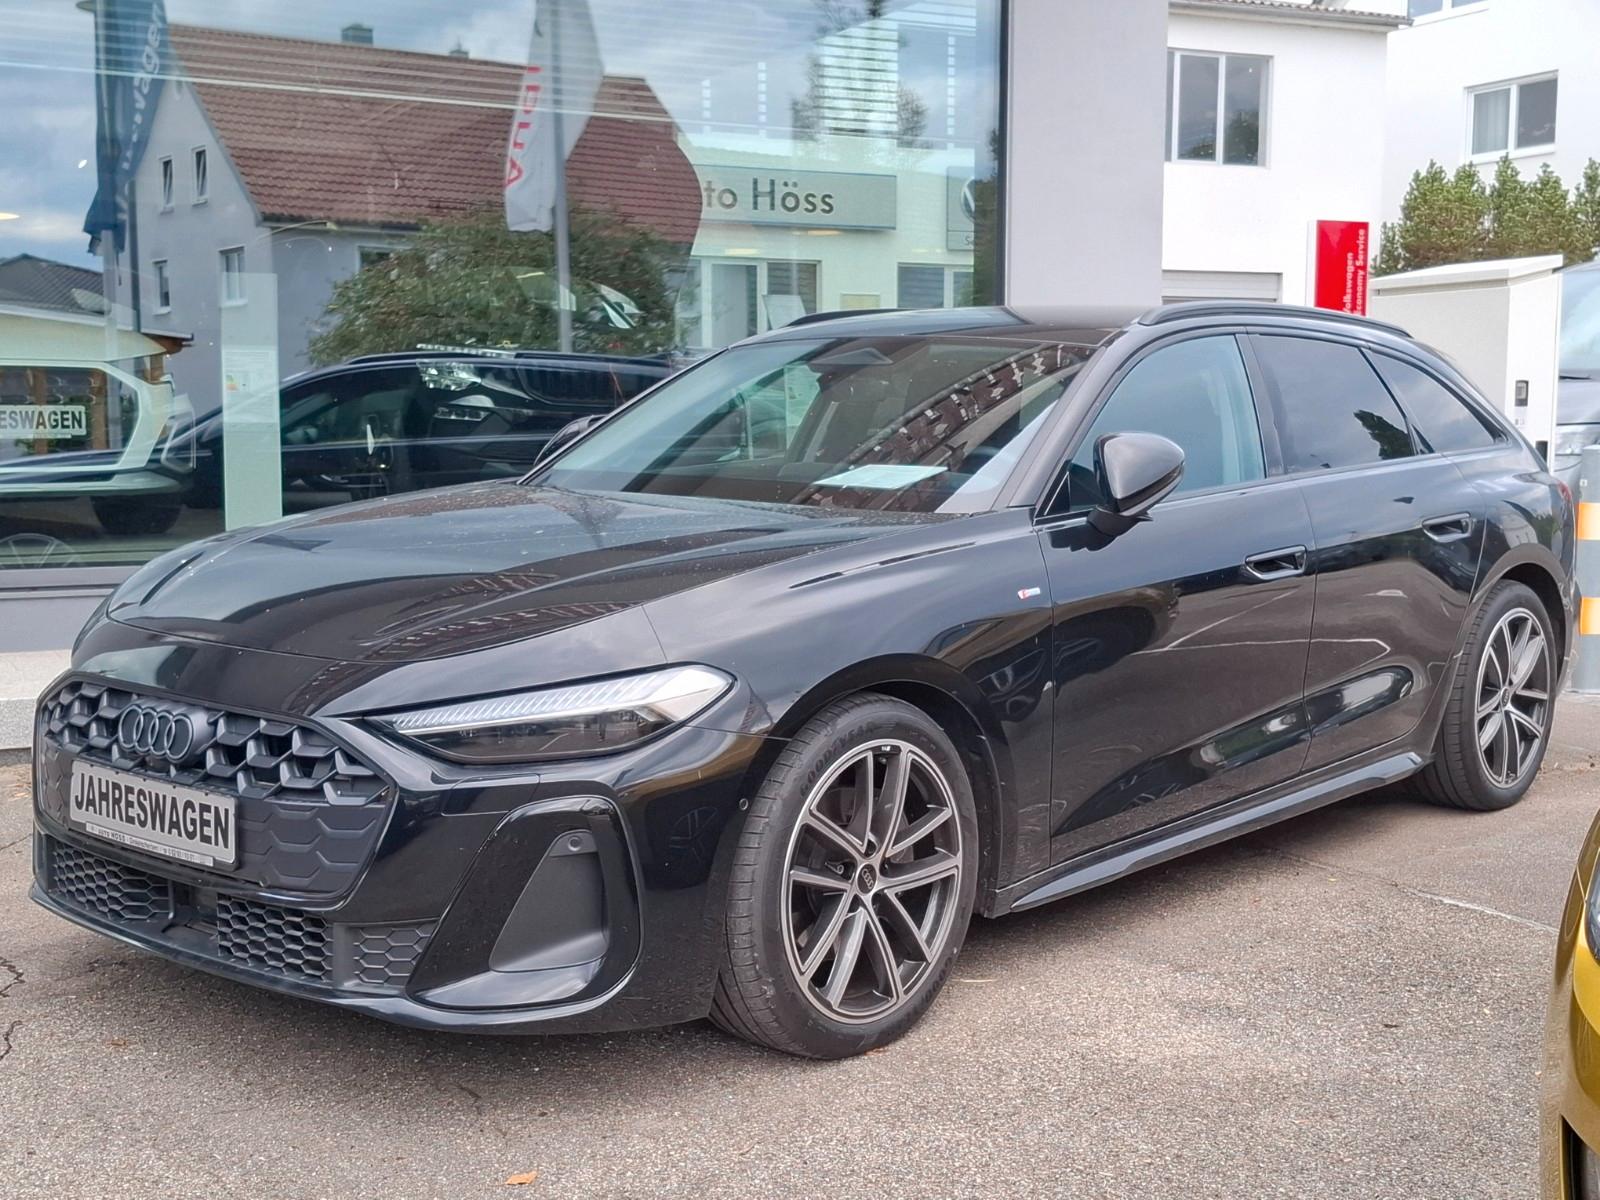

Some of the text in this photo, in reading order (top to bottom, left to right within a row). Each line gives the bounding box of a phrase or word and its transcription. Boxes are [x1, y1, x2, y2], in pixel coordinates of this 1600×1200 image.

[751, 176, 834, 214] Höss
[1355, 228, 1366, 267] Service
[0, 410, 83, 430] ESWAGEN
[74, 772, 229, 850] JAHRESWAGEN
